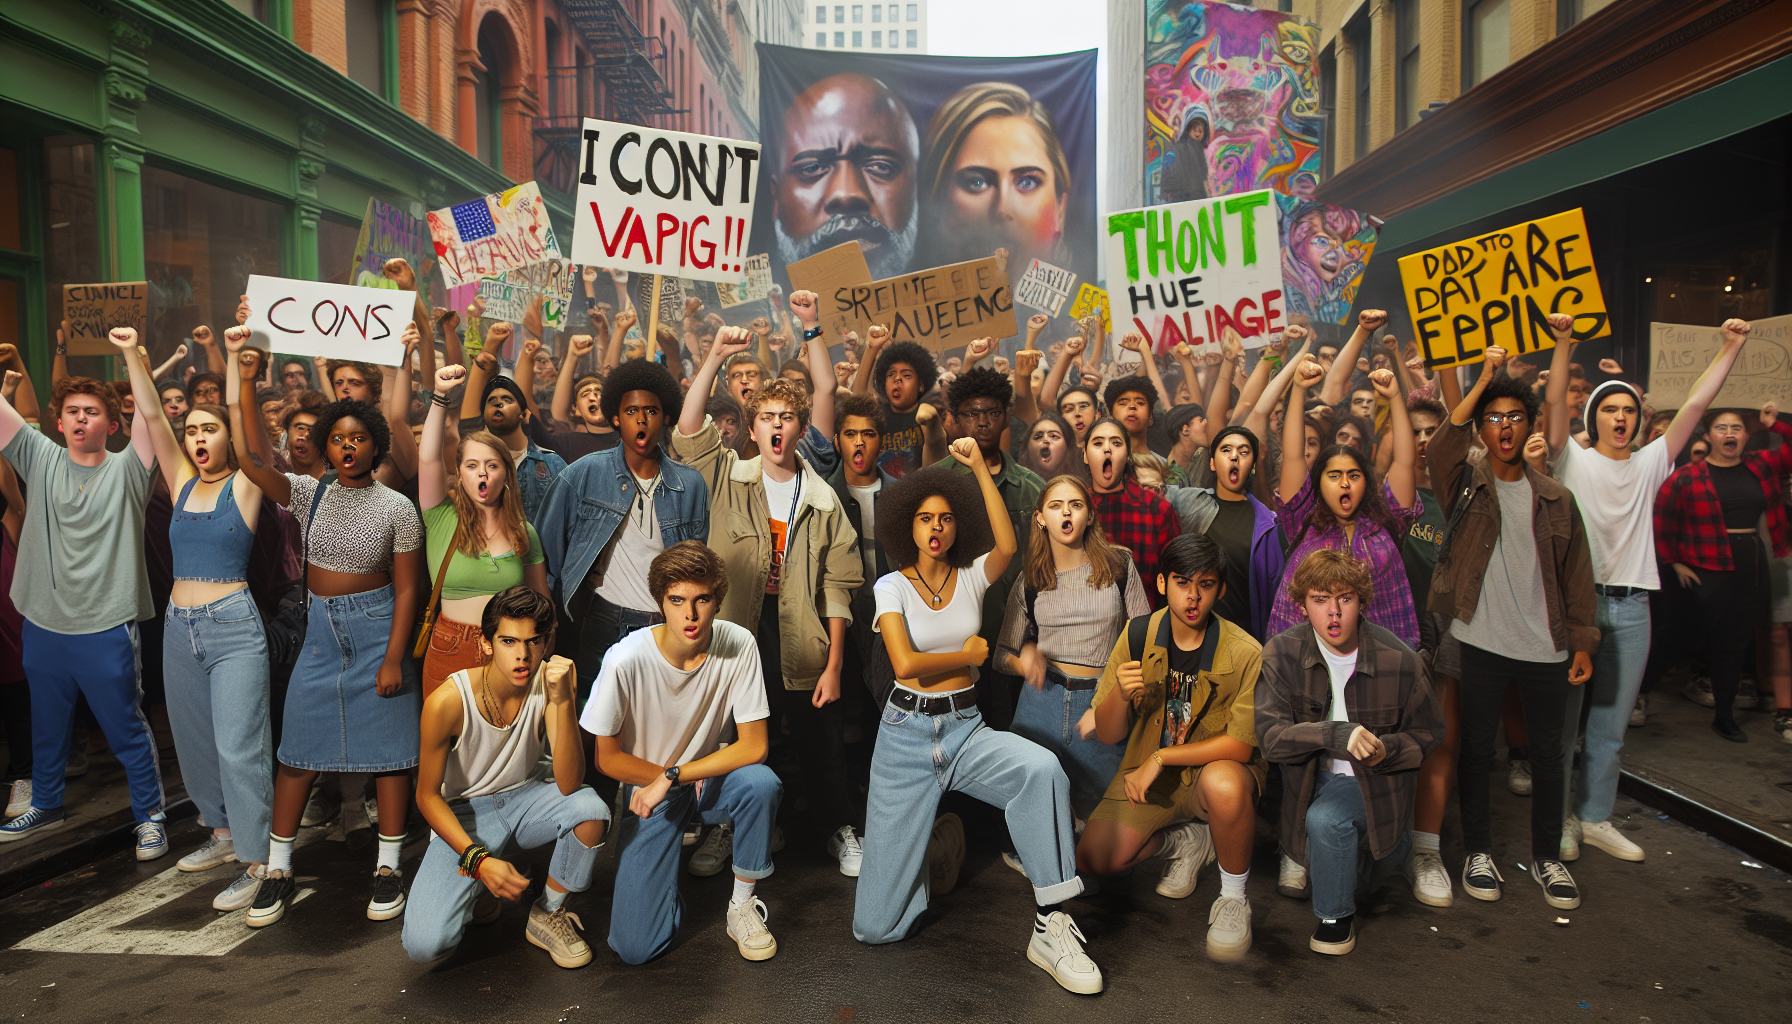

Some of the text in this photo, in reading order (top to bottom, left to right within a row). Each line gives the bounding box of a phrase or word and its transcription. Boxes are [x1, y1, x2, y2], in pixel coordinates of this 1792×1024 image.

[580, 129, 600, 185] I
[590, 201, 745, 272] VAPIG!!
[1108, 191, 1270, 283] THONT
[1501, 223, 1592, 295] ARE
[268, 296, 393, 341] CONS
[1128, 276, 1204, 315] HUE
